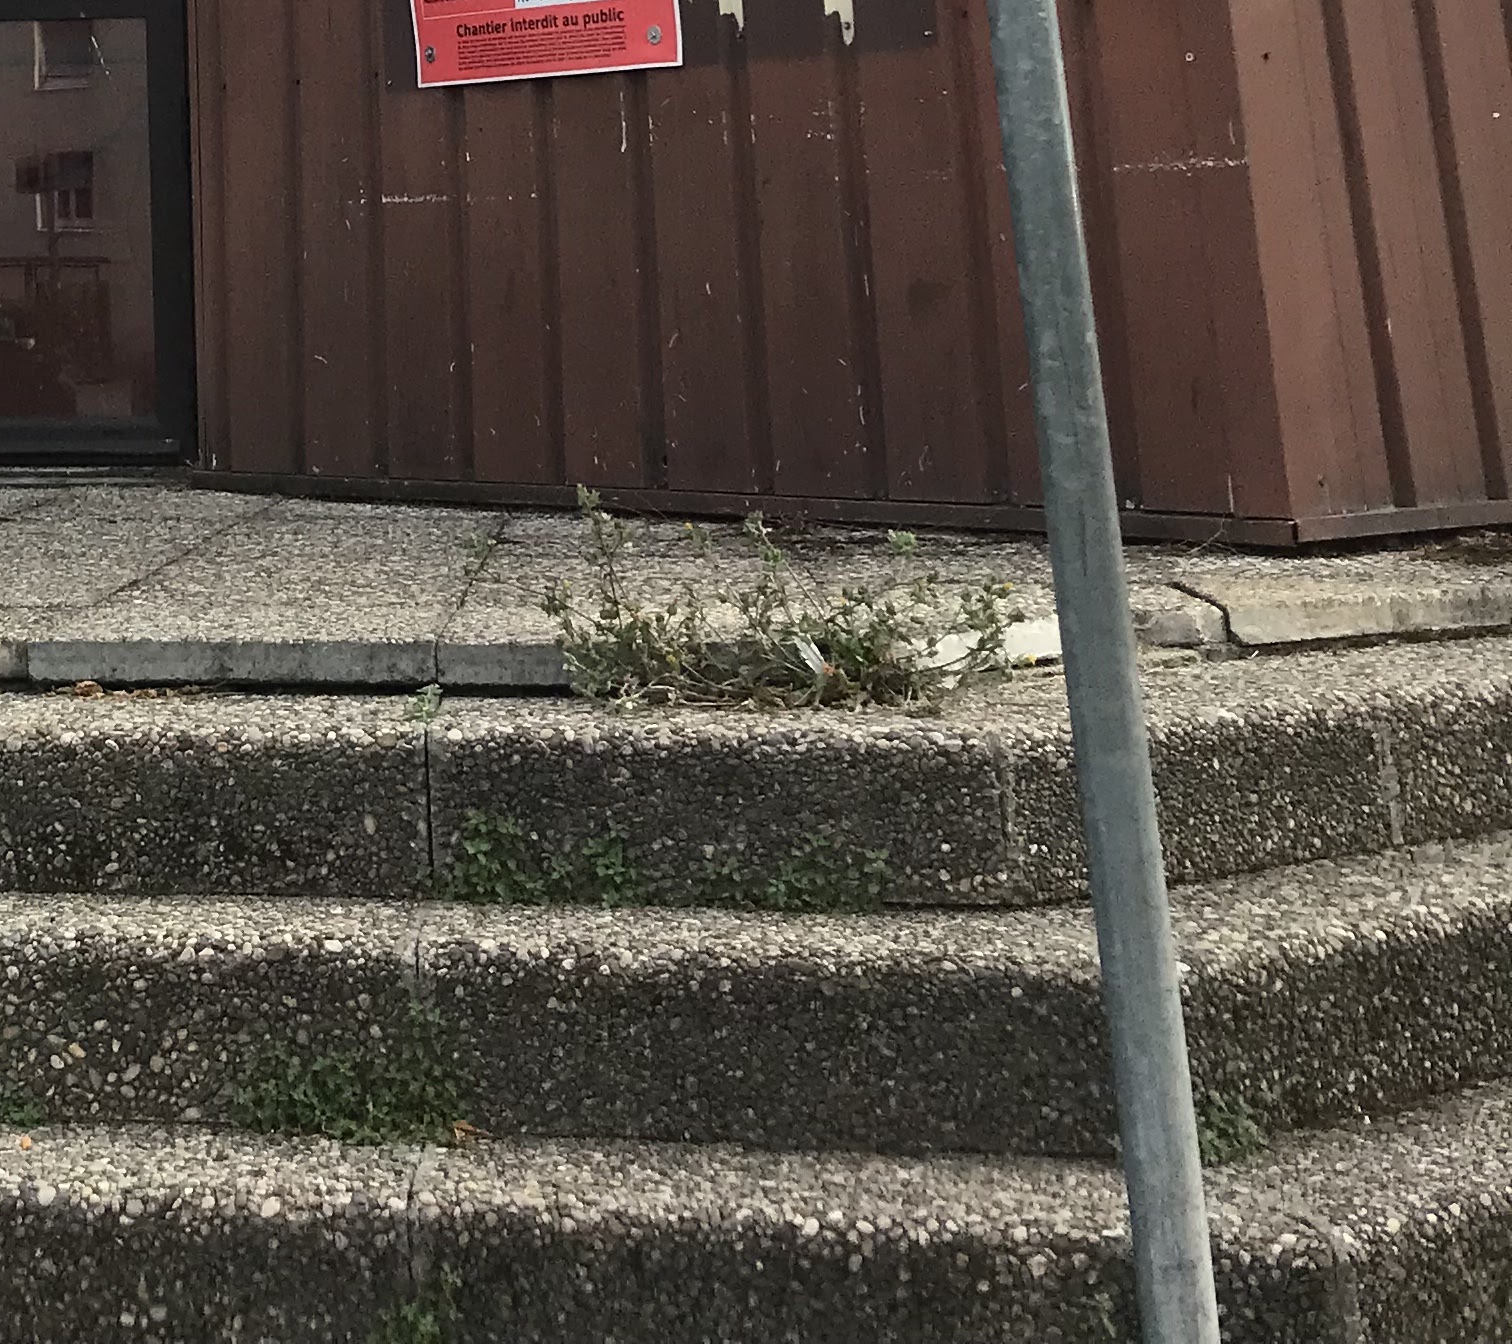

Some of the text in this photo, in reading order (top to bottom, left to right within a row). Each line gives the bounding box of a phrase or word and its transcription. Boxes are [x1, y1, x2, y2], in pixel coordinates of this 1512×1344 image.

[456, 7, 625, 38] Chantier interdit au public
